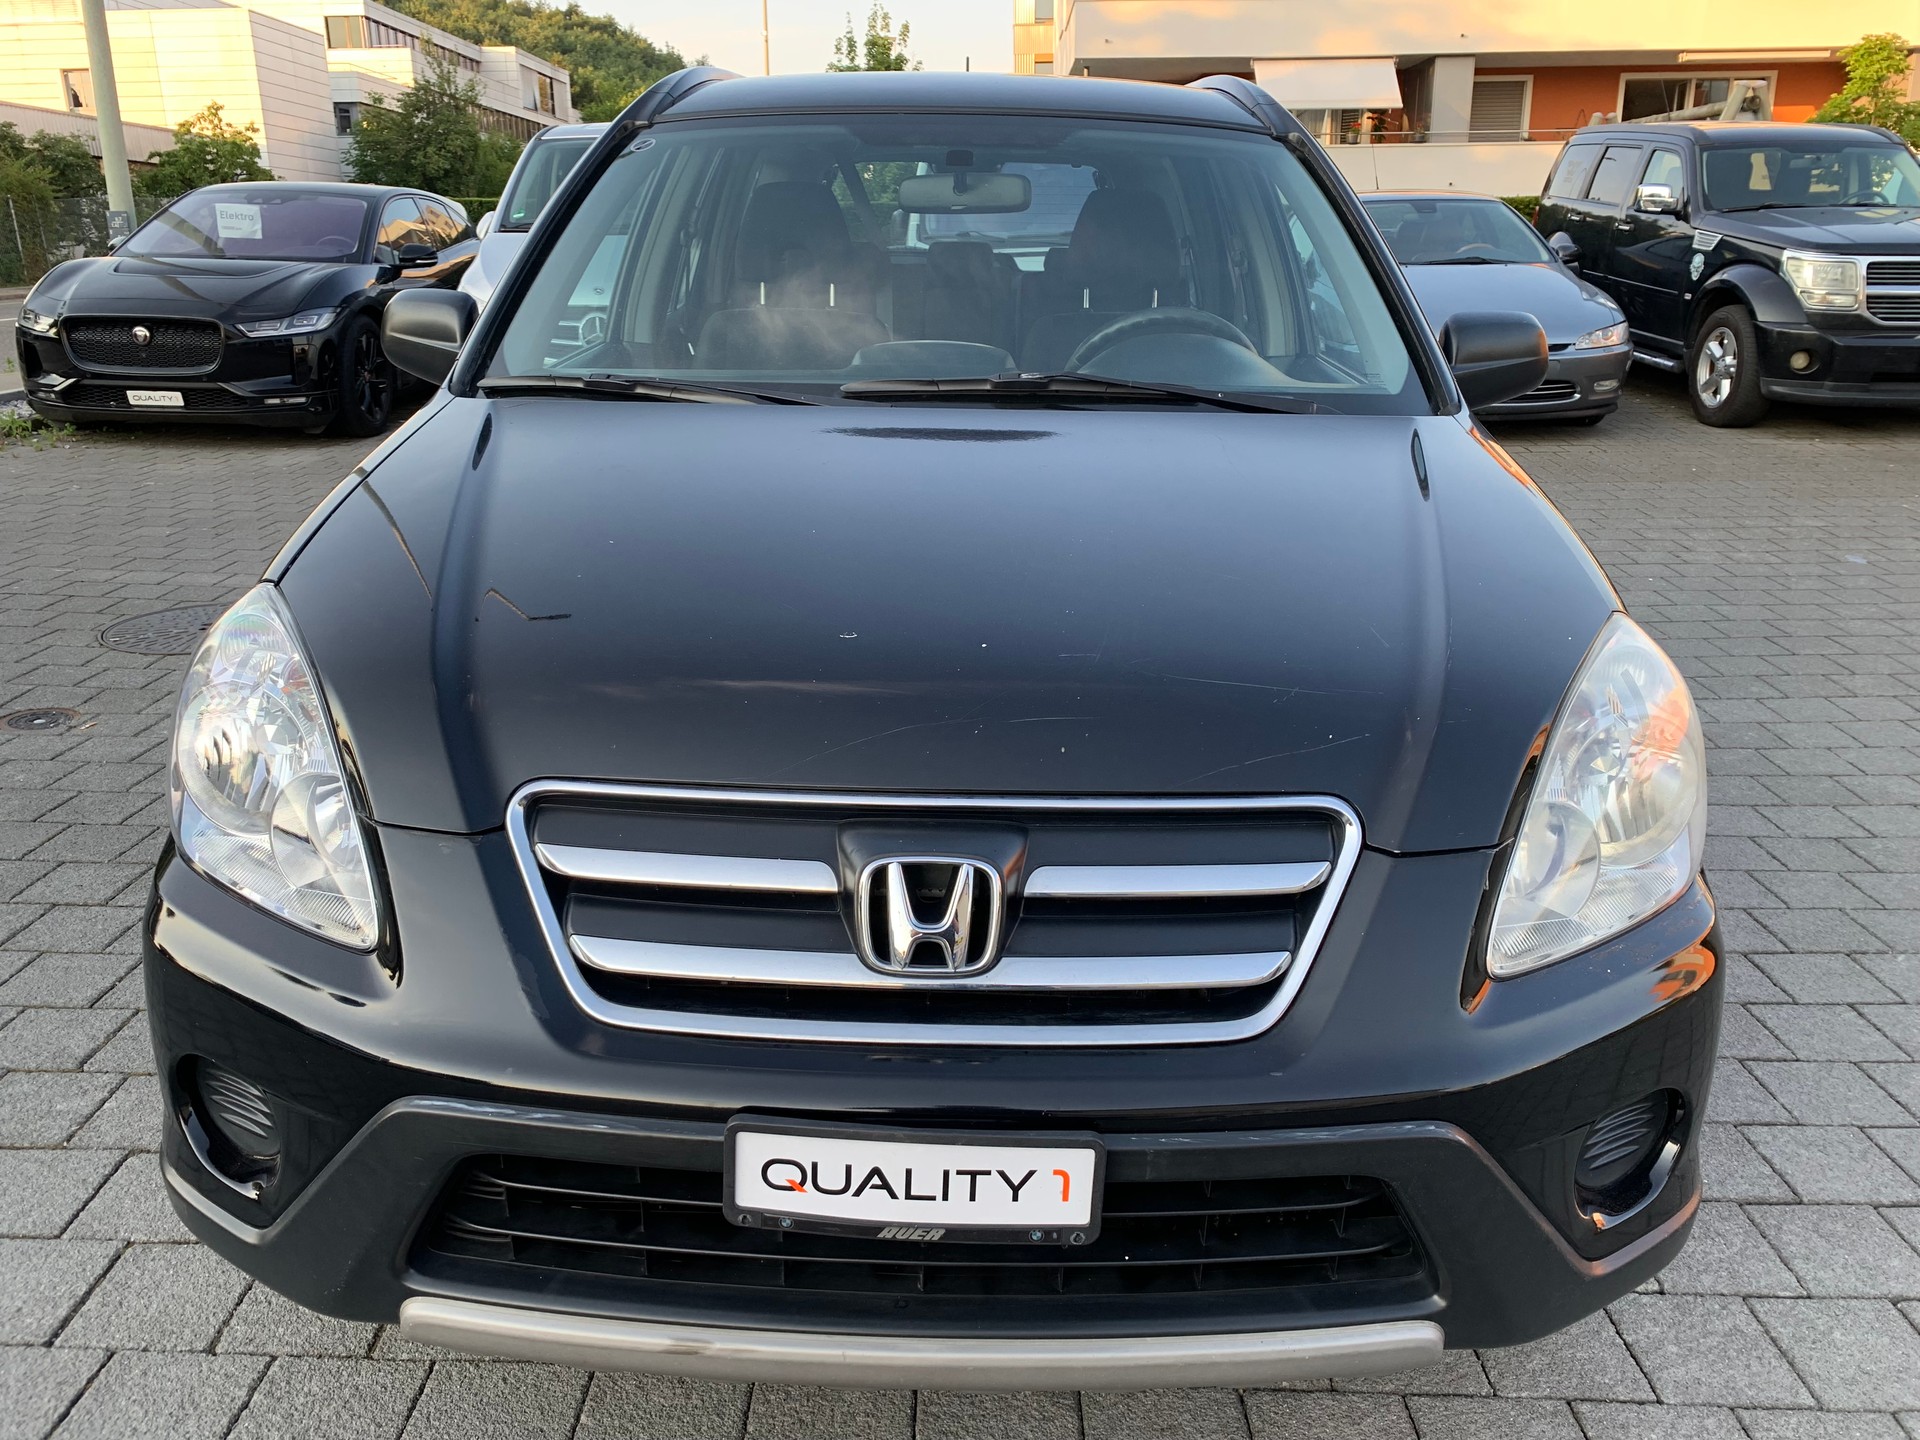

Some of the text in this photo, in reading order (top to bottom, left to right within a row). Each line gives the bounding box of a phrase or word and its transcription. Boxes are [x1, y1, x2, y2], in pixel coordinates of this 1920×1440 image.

[220, 210, 254, 221] Elektro
[761, 1157, 1071, 1202] QUALITY 1
[876, 1226, 946, 1241] AUER
